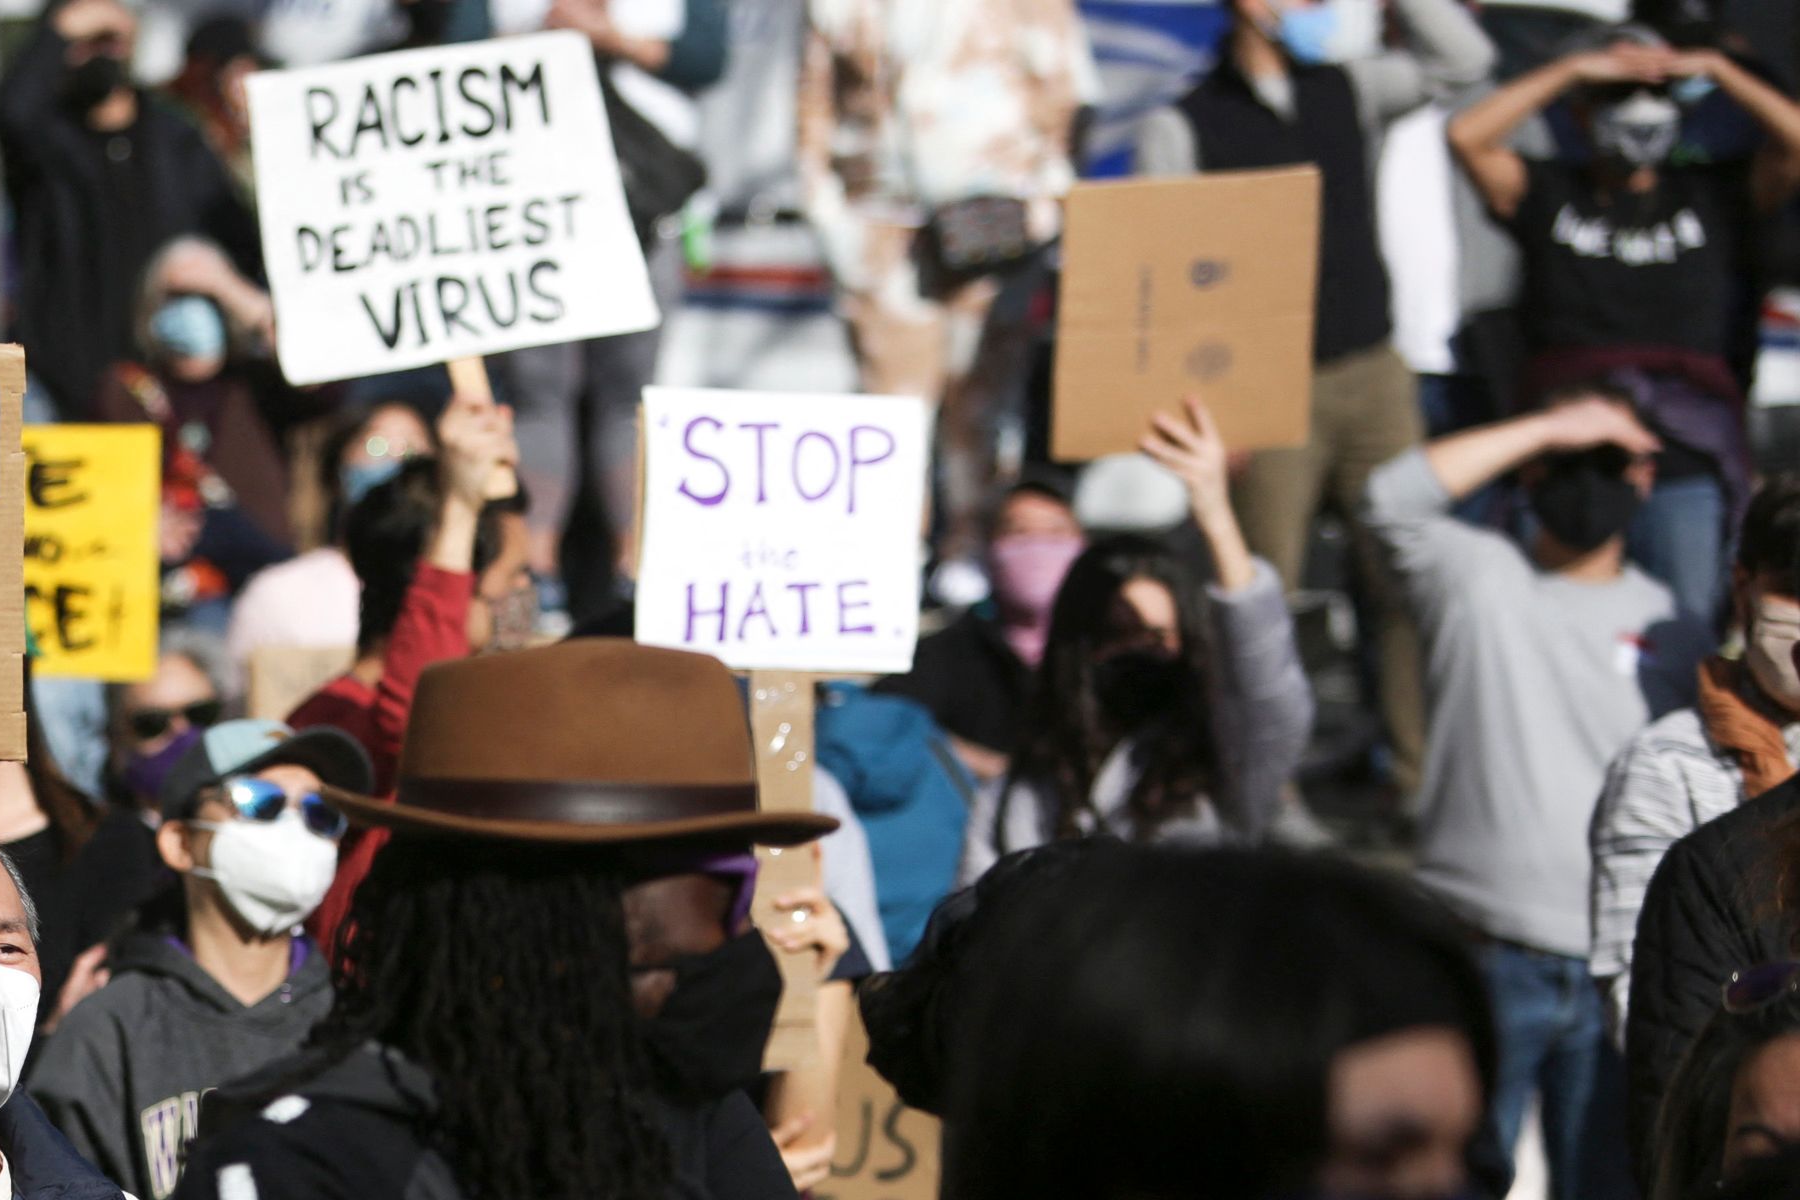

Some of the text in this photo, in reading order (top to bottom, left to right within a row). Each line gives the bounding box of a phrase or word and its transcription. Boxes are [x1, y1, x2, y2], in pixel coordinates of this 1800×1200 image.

[304, 59, 550, 159] RACISM
[338, 149, 512, 206] IS THE
[296, 191, 584, 273] DEADLIEST
[358, 258, 566, 350] VIRUS
[676, 415, 897, 515] STOP
